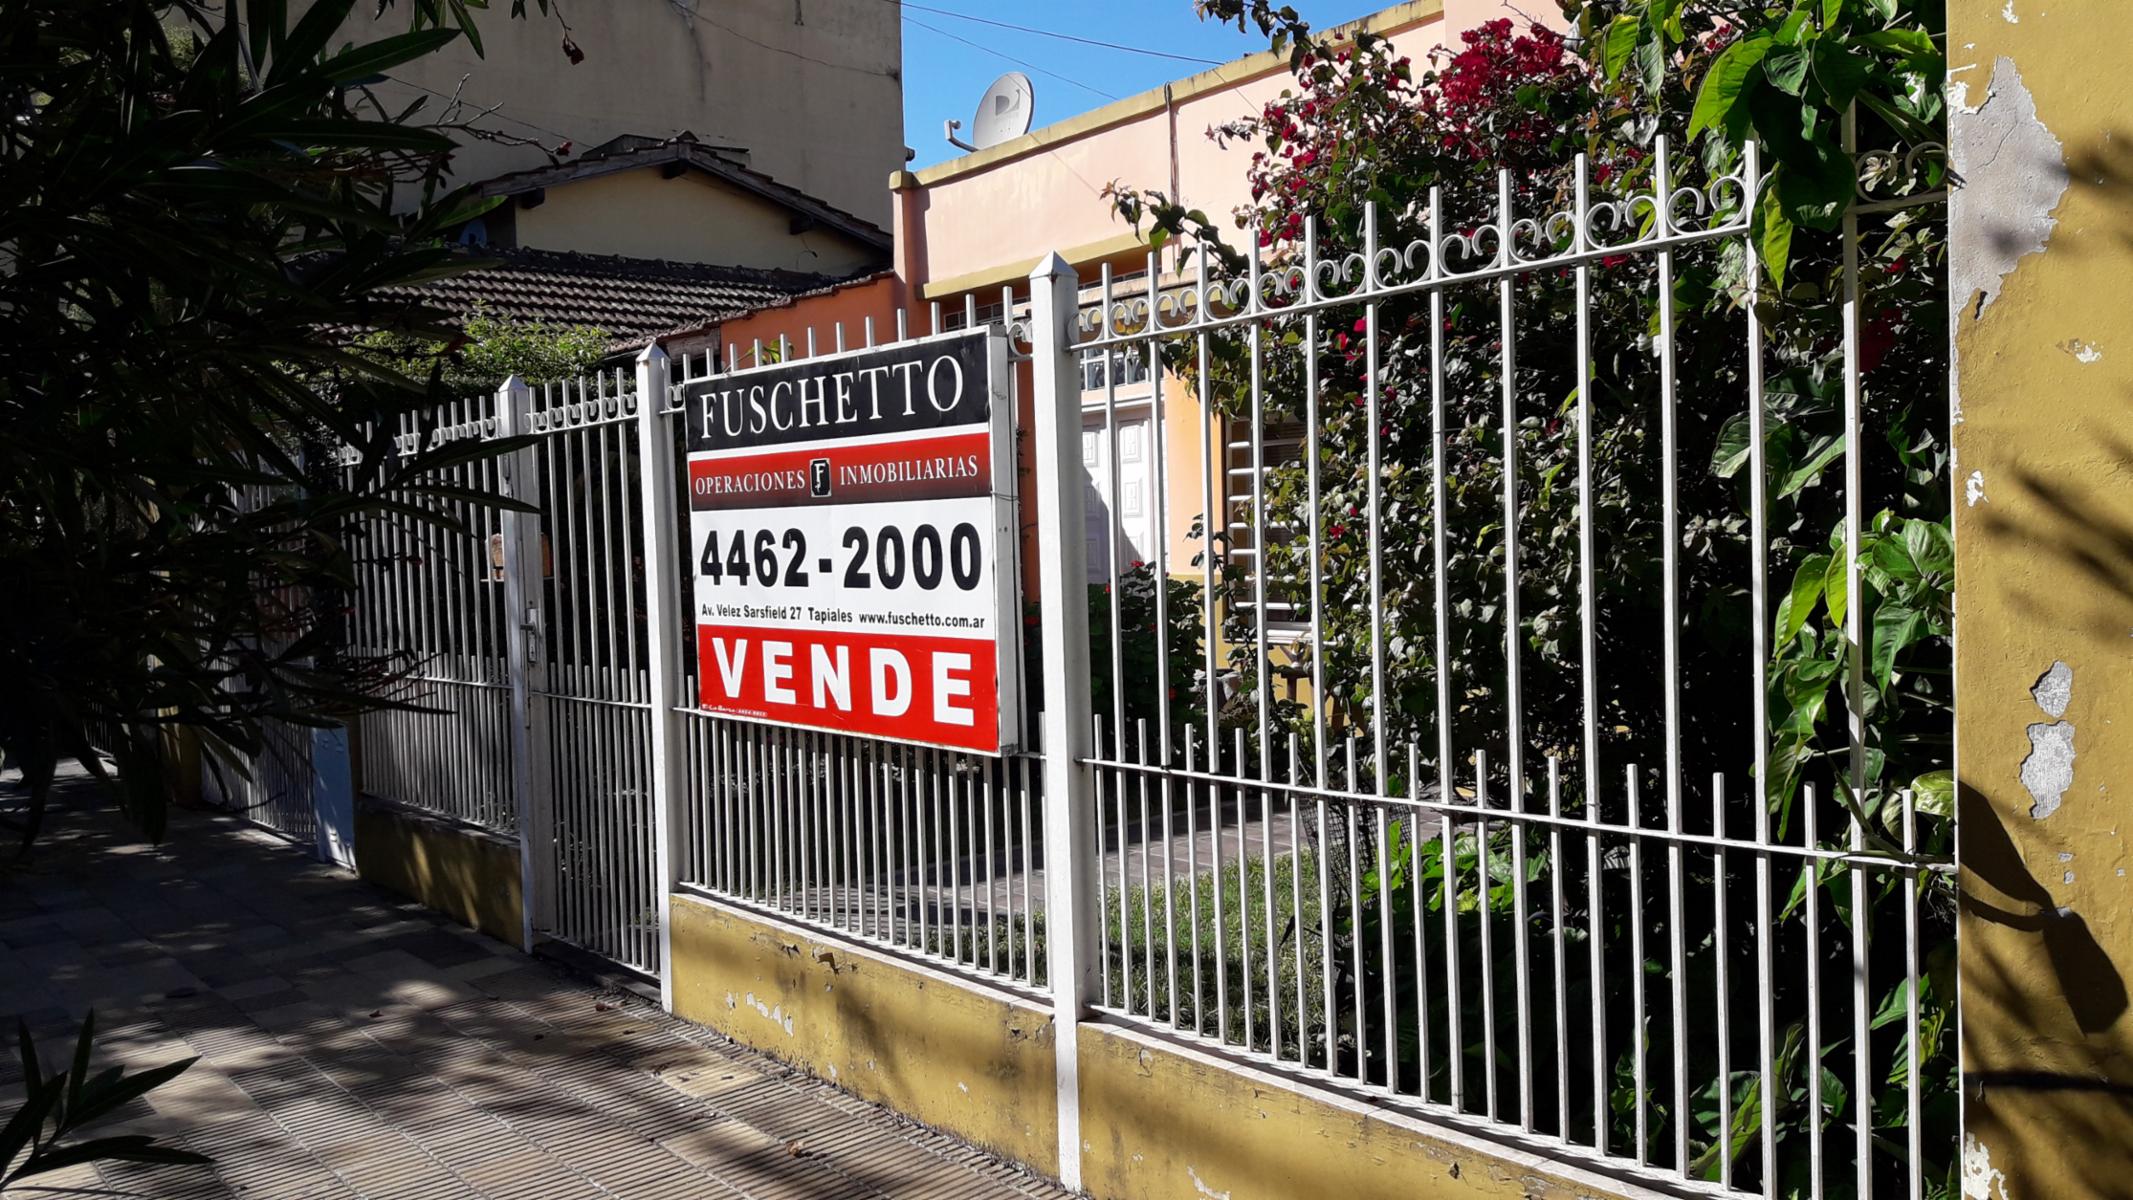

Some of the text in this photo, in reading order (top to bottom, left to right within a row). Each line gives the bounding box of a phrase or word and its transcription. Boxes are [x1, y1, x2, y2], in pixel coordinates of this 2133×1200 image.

[700, 355, 964, 440] FUSCHETTO
[695, 470, 806, 495] OPERACIONES
[840, 455, 979, 486] INMOBILIARIAS
[700, 522, 982, 591] 4462-2000
[701, 603, 985, 628] Av. Velez Sarsfield 27 Tapiales www.fuschetto.com.ar
[712, 637, 975, 727] VENDE
